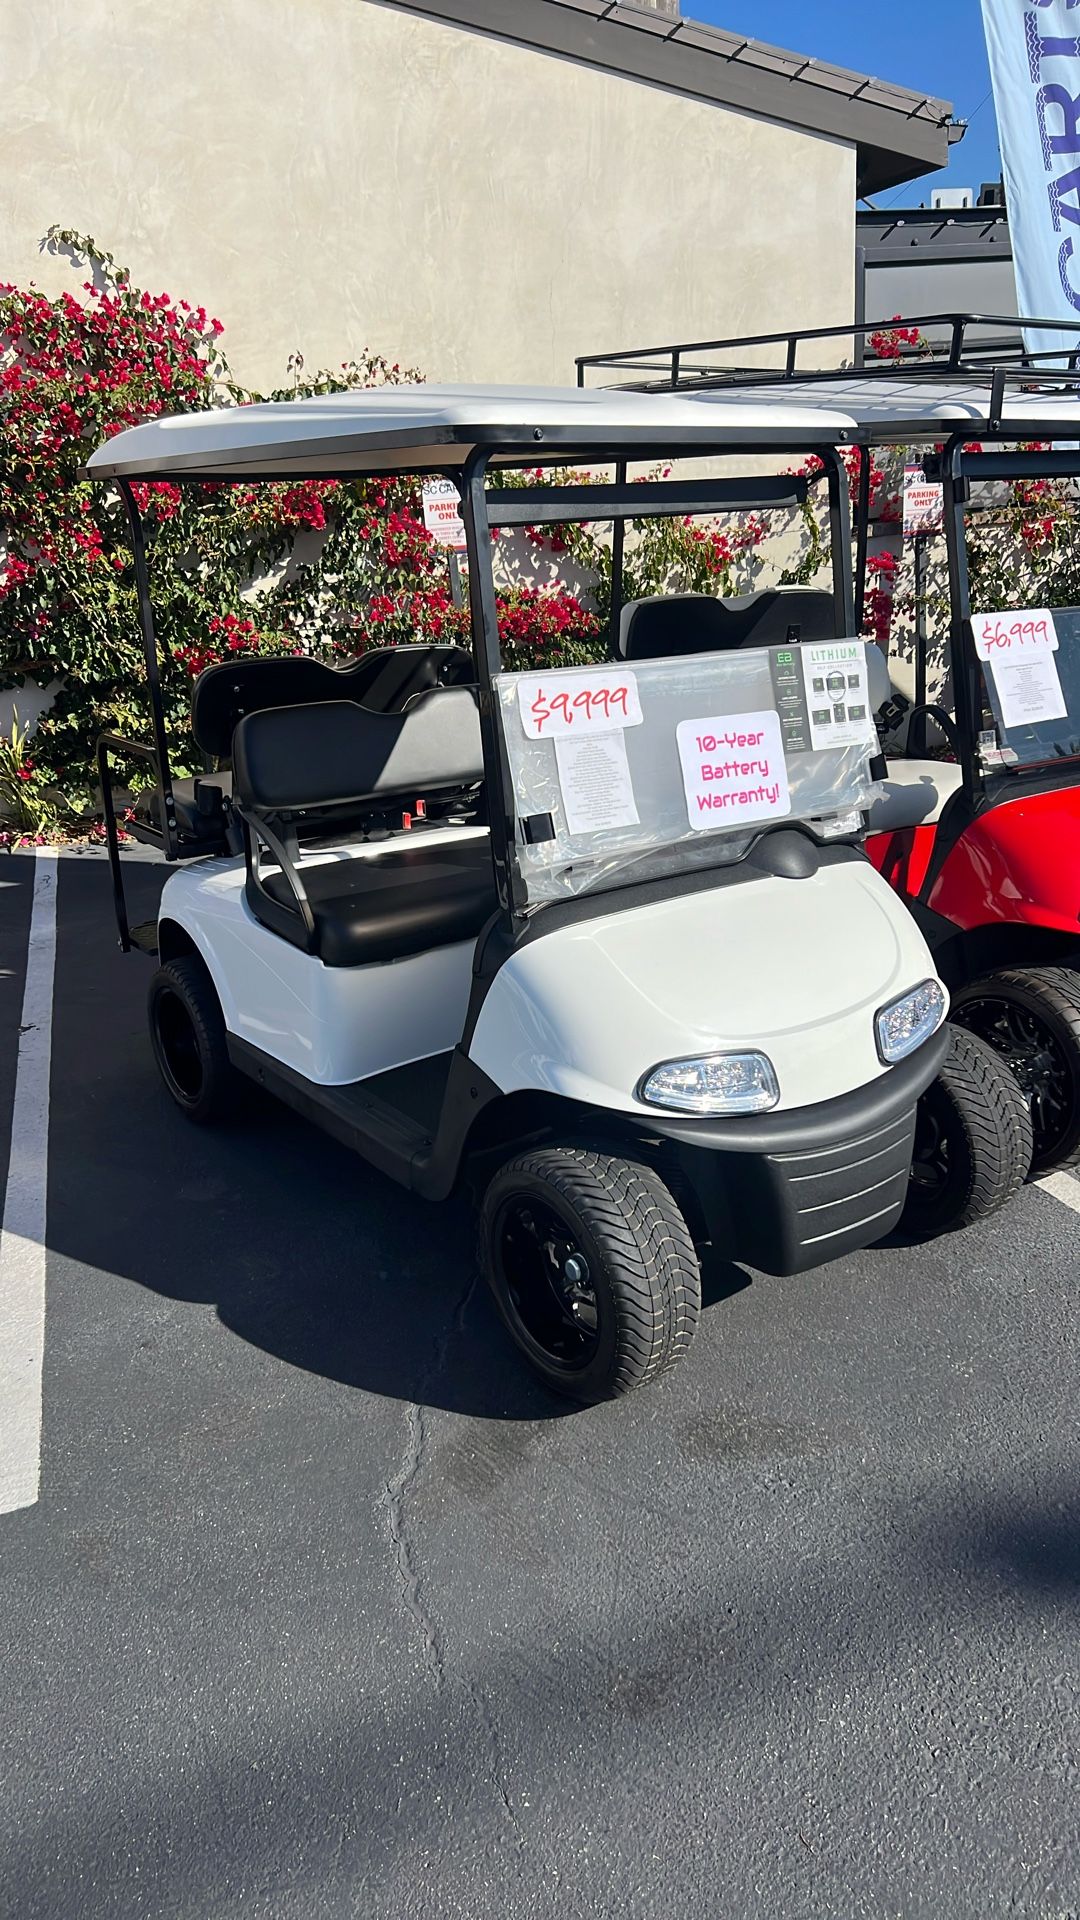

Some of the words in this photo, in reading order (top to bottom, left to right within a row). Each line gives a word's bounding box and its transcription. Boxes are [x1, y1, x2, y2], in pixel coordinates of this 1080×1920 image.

[1023, 0, 1080, 313] ART
[907, 490, 939, 499] PARKING
[914, 499, 933, 507] ONLY
[429, 503, 458, 512] PARKI
[438, 512, 457, 520] ONL
[982, 620, 1048, 653] $6,999
[811, 647, 857, 661] LITHIUM
[531, 687, 628, 732] $9,999
[696, 732, 764, 753] 10-Year
[701, 760, 769, 781] Battery
[697, 783, 780, 811] Warranty!
